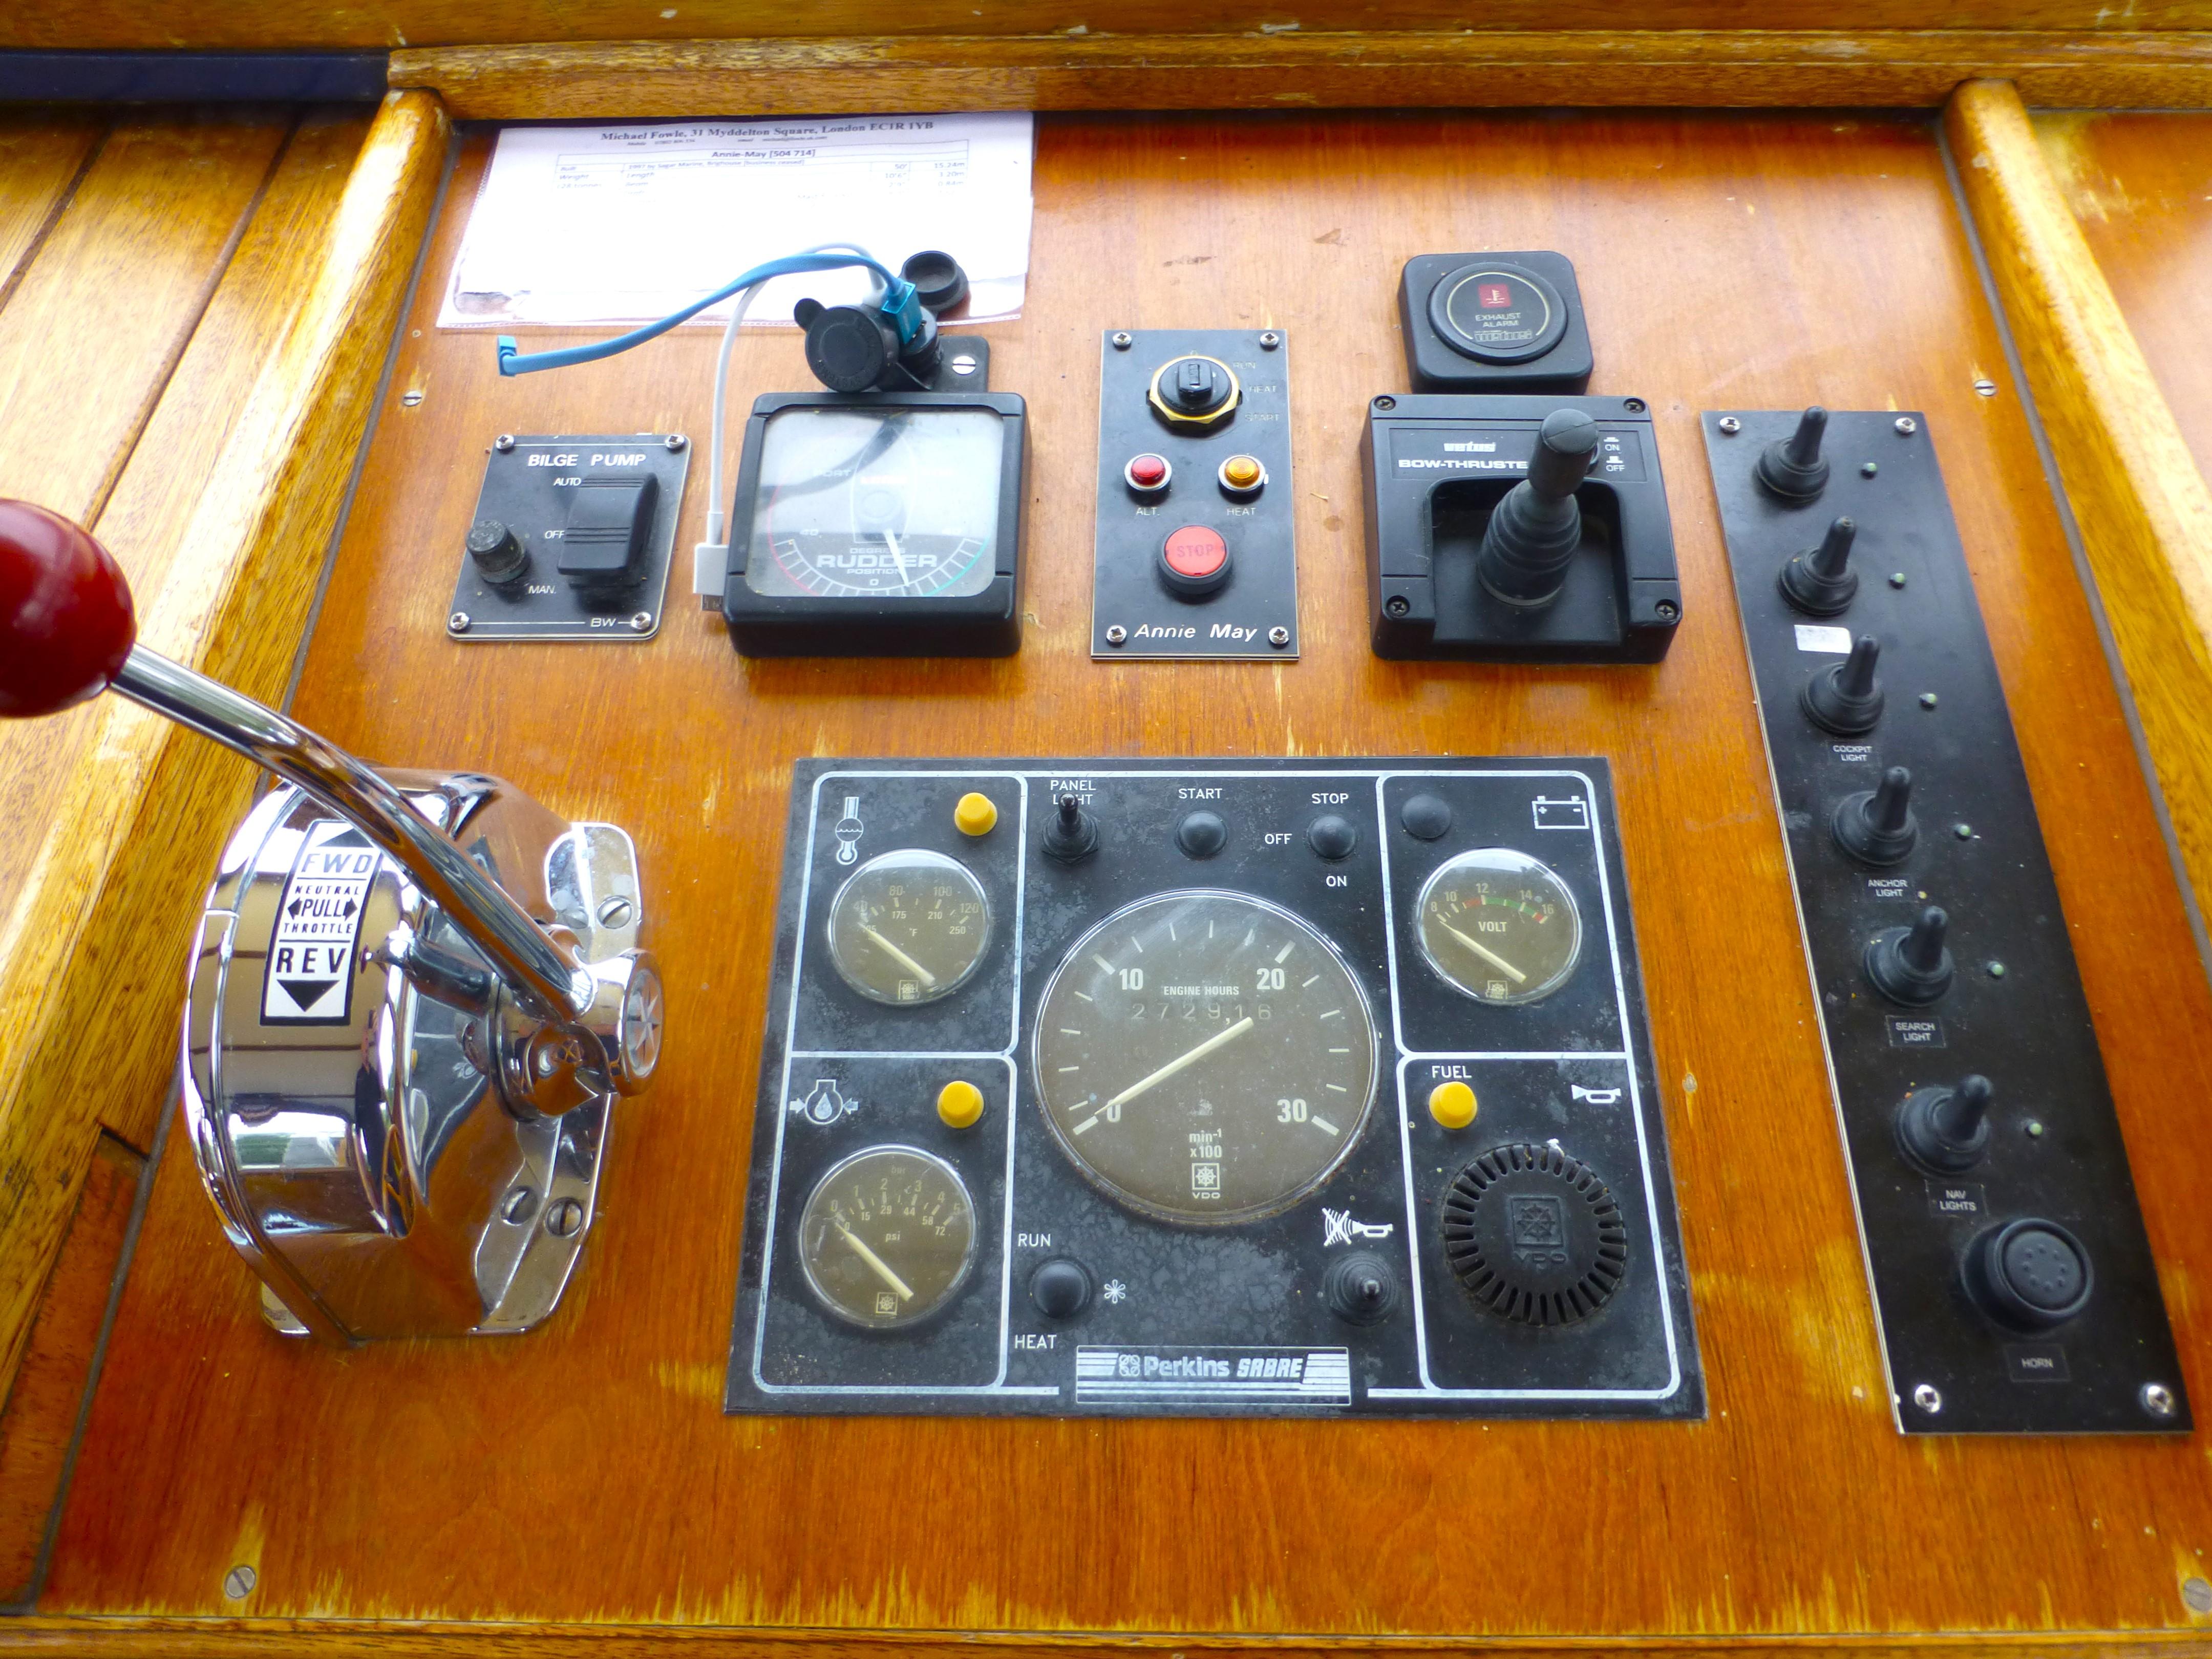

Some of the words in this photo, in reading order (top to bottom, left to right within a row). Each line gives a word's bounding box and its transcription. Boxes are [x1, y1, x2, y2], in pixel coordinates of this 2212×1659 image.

[601, 132, 647, 140] Michael
[650, 130, 688, 139] Fowle,
[708, 127, 770, 137] Myddelton
[774, 126, 818, 137] Square,
[821, 125, 865, 134] London
[1475, 312, 1521, 322] EXHAUST
[1482, 320, 1520, 328] ALARM
[528, 454, 578, 466] BILGE
[590, 454, 646, 466] PUMP
[1398, 459, 1528, 470] BOW-THRUSTE
[1606, 464, 1625, 473] OFF
[554, 478, 582, 486] AUTO
[1227, 507, 1257, 516] HEAT
[545, 530, 565, 539] OFF
[1177, 544, 1215, 558] STOP
[816, 554, 938, 568] RUDDER
[528, 585, 557, 594] MAN.
[590, 618, 616, 627] BW
[1134, 624, 1196, 639] Annie
[1209, 624, 1258, 642] May
[1833, 745, 1872, 754] COCKPIT
[1841, 754, 1867, 762] LIGHT
[1050, 780, 1097, 791] PANEL
[1178, 788, 1223, 799] START
[1311, 793, 1349, 804] STOP
[1053, 794, 1093, 805] LHT
[1265, 834, 1292, 845] OFF
[301, 853, 373, 874] FWD
[1326, 876, 1347, 887] ON
[1867, 879, 1907, 888] ANCHOR
[294, 885, 360, 896] NEUTRAL
[889, 885, 903, 896] 80
[933, 886, 953, 897] 100
[1476, 883, 1489, 894] 12
[1876, 888, 1903, 898] LIGHT
[1445, 891, 1457, 902] 10
[1520, 890, 1533, 900] 14
[301, 899, 345, 917] PULL
[960, 902, 980, 914] 120
[1431, 901, 1438, 912] 8
[1542, 903, 1554, 914] 16
[892, 911, 907, 919] 175
[928, 911, 943, 920] 210
[284, 923, 353, 934] THROTTLE
[949, 926, 967, 935] 250
[1478, 921, 1507, 932] VOLT
[276, 948, 347, 973] REV
[1119, 968, 1143, 990] 10
[1256, 968, 1285, 990] 20
[1163, 986, 1201, 995] ENGINE
[1205, 986, 1239, 995] HOURS
[1896, 1022, 1935, 1032] SEARCH
[1903, 1032, 1931, 1041] LIGHT
[1432, 1065, 1472, 1078] FUEL
[1107, 1100, 1121, 1123] 0
[1277, 1099, 1307, 1122] 30
[1190, 1145, 1223, 1158] x100
[880, 1178, 888, 1190] 2
[914, 1180, 922, 1192] 3
[938, 1191, 946, 1203] 4
[1945, 1190, 1966, 1200] NAV
[880, 1205, 892, 1215] 29
[1940, 1200, 1976, 1211] LIGHTS
[861, 1211, 870, 1221] 15
[903, 1207, 916, 1216] 44
[922, 1216, 934, 1225] 58
[885, 1230, 901, 1243] psi
[935, 1226, 946, 1236] 72
[1018, 1233, 1051, 1247] RUN
[1014, 1335, 1057, 1349] HEAT
[1144, 1356, 1230, 1377] Perkins
[1237, 1358, 1303, 1377] SABRE
[2022, 1357, 2053, 1368] HORN
